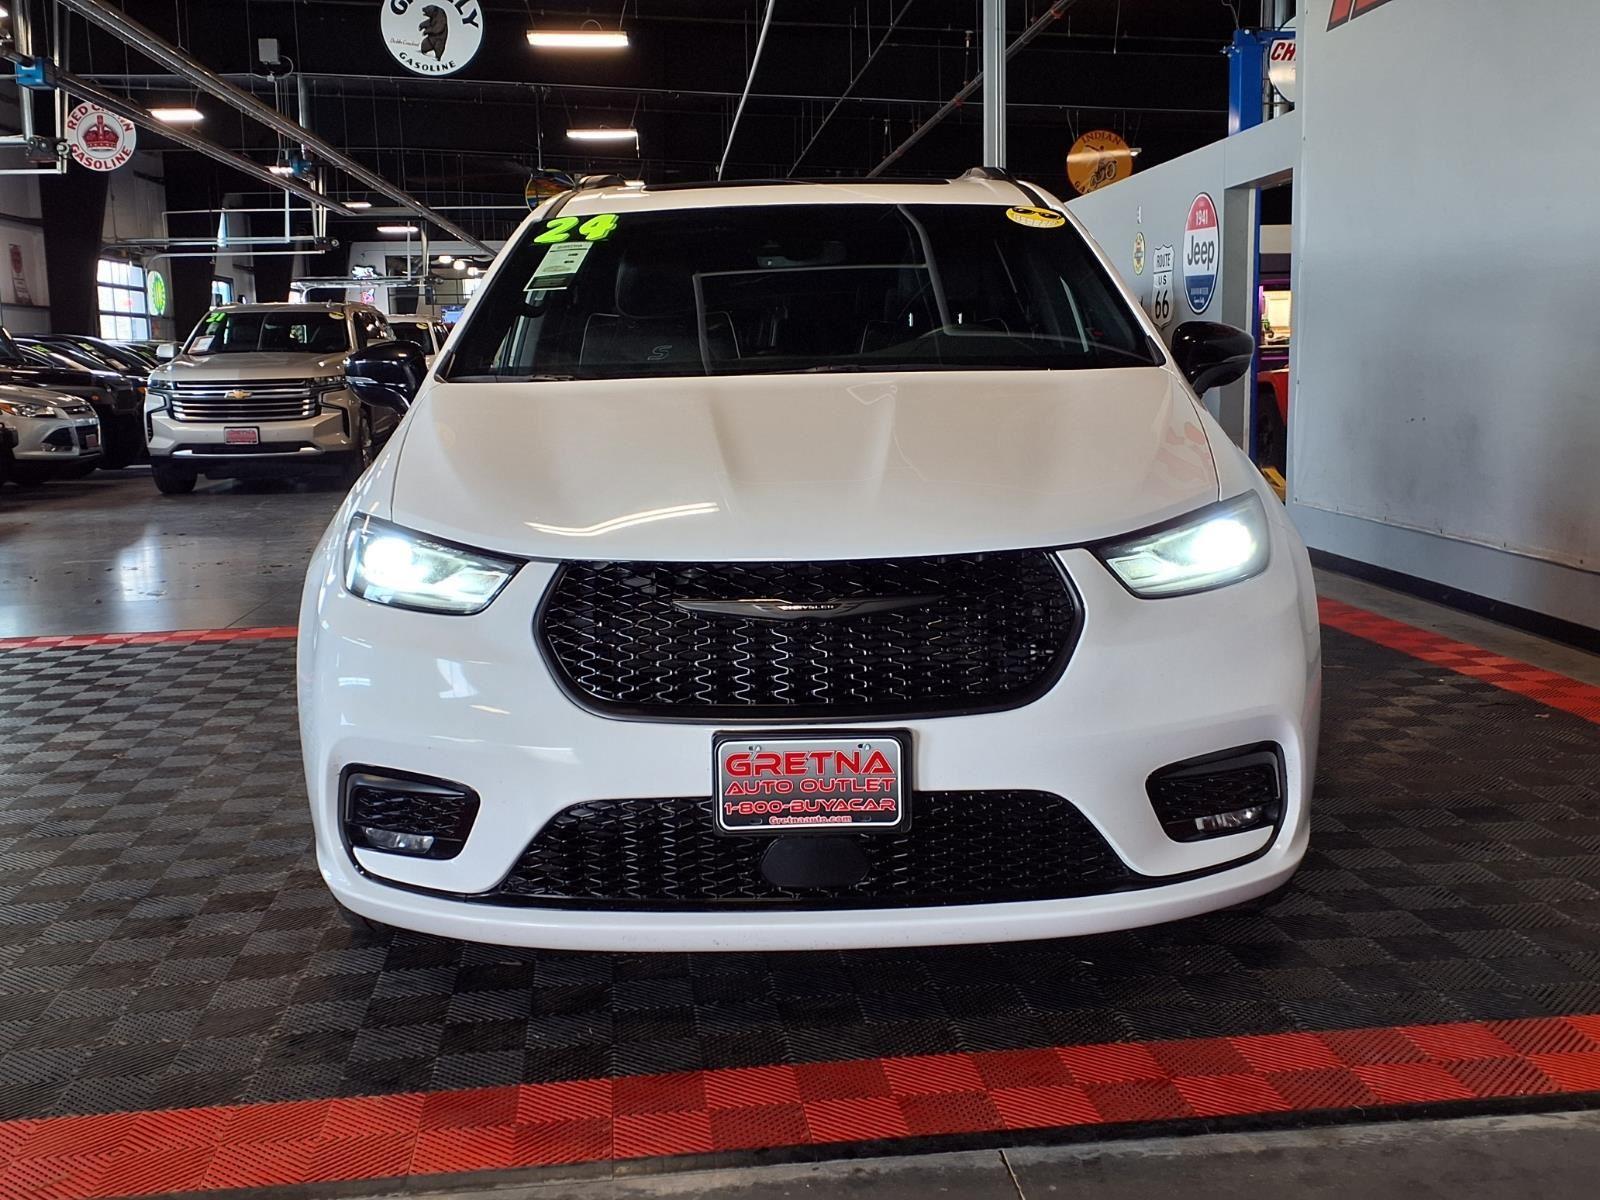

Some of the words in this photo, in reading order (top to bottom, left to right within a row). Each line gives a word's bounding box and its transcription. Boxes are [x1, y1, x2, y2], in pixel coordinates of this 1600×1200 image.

[399, 52, 456, 71] GASOLINE
[67, 106, 88, 130] RED
[1081, 132, 1121, 145] INDIAN
[70, 143, 132, 170] GASOLINE
[1195, 209, 1208, 225] 1941
[534, 214, 619, 243] 24
[1156, 253, 1171, 268] ROUTE
[1187, 235, 1215, 271] Jeep
[1154, 290, 1170, 319] 66
[725, 750, 895, 777] GRETNA
[725, 780, 793, 796] AUTO
[800, 777, 897, 793] OUTLET
[724, 798, 896, 815] 1-800-BUYACAR
[768, 815, 853, 825] Gretnaauto.com
